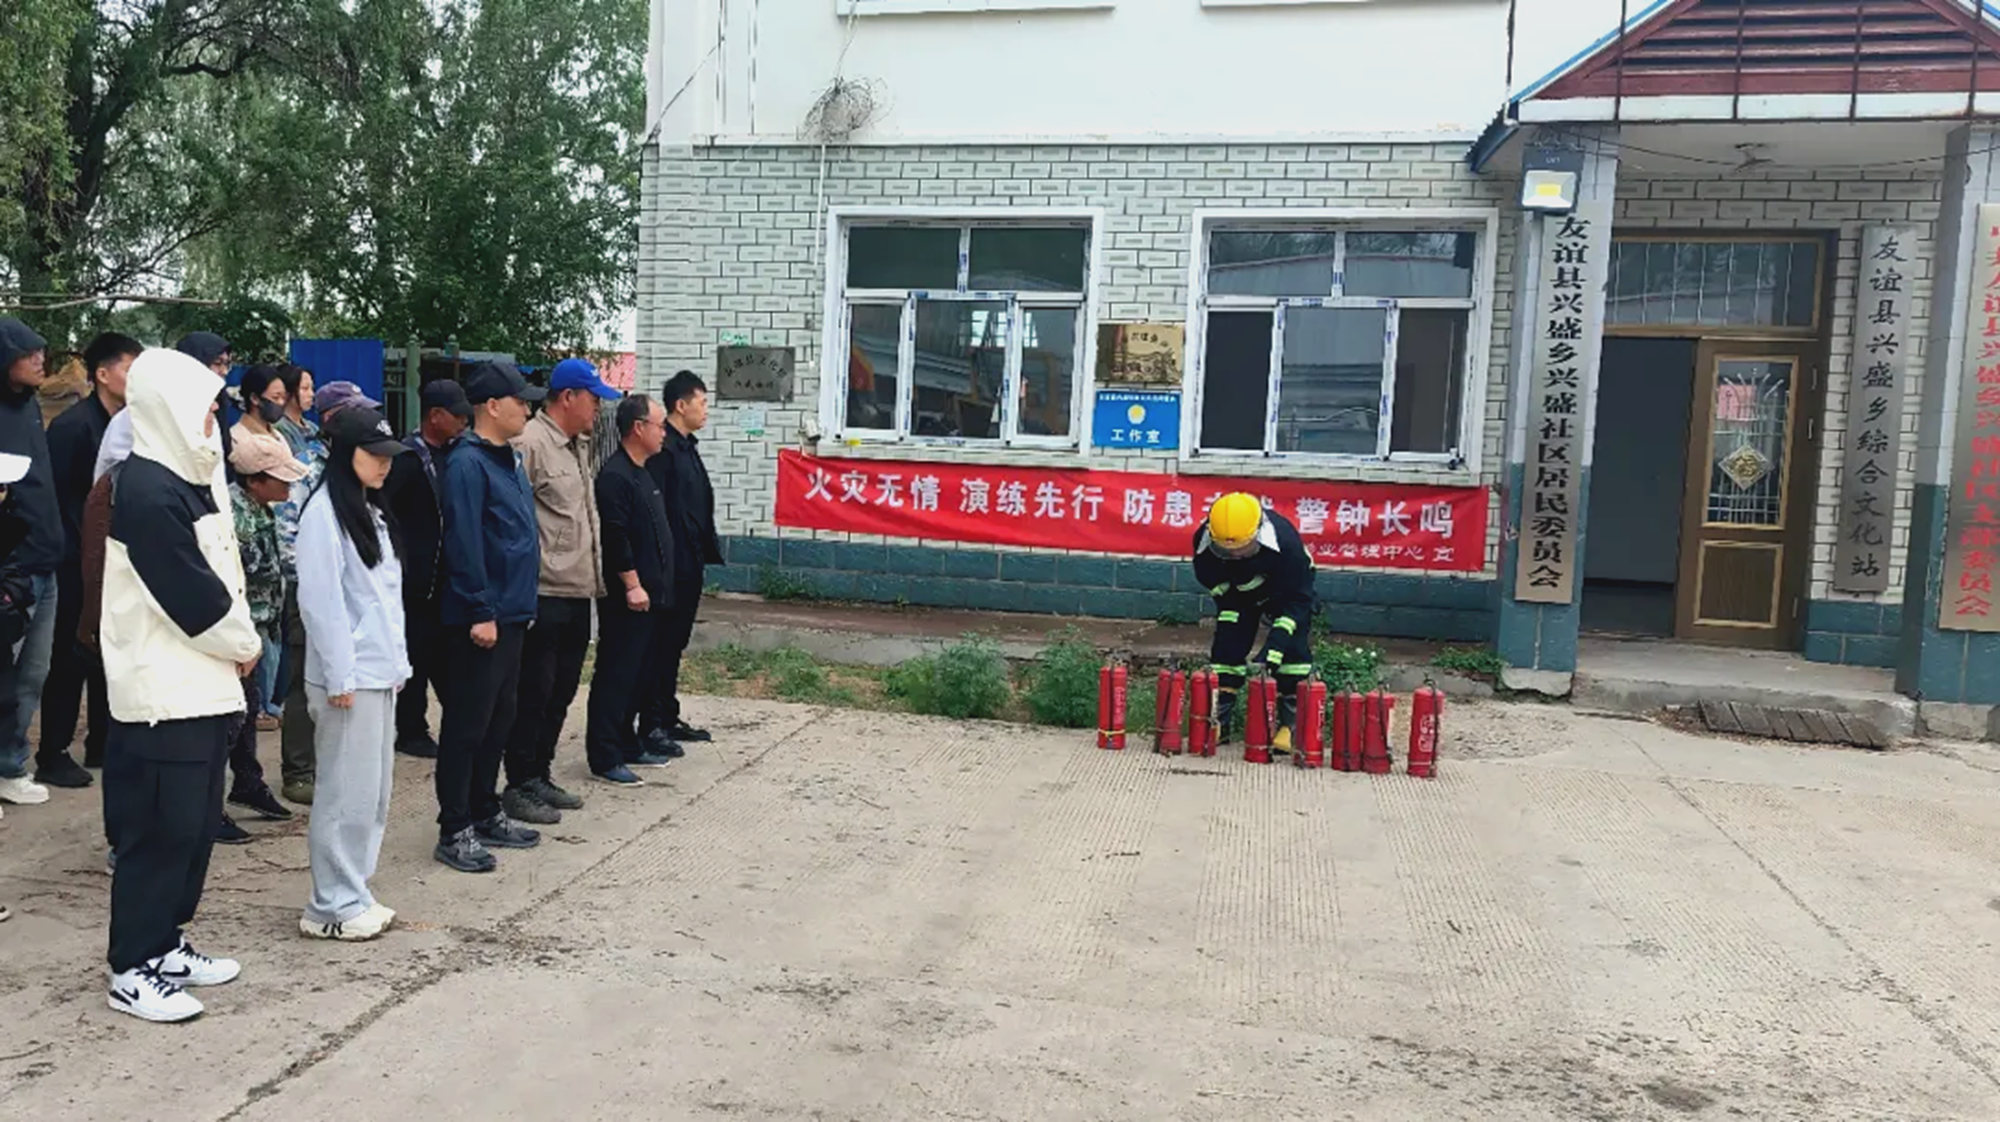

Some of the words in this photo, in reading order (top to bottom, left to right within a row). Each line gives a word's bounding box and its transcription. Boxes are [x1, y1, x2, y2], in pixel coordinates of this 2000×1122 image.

[804, 466, 942, 512] 火灾无情
[959, 477, 1104, 521] 演练先行
[1122, 488, 1274, 527] 防患
[1296, 497, 1454, 539] 警钟长鸣
[1110, 428, 1160, 443] 工作室
[1528, 216, 1591, 587] 友谊县兴盛乡兴盛社区居民委员会
[1850, 235, 1908, 578] 友谊县兴盛乡综合文化站
